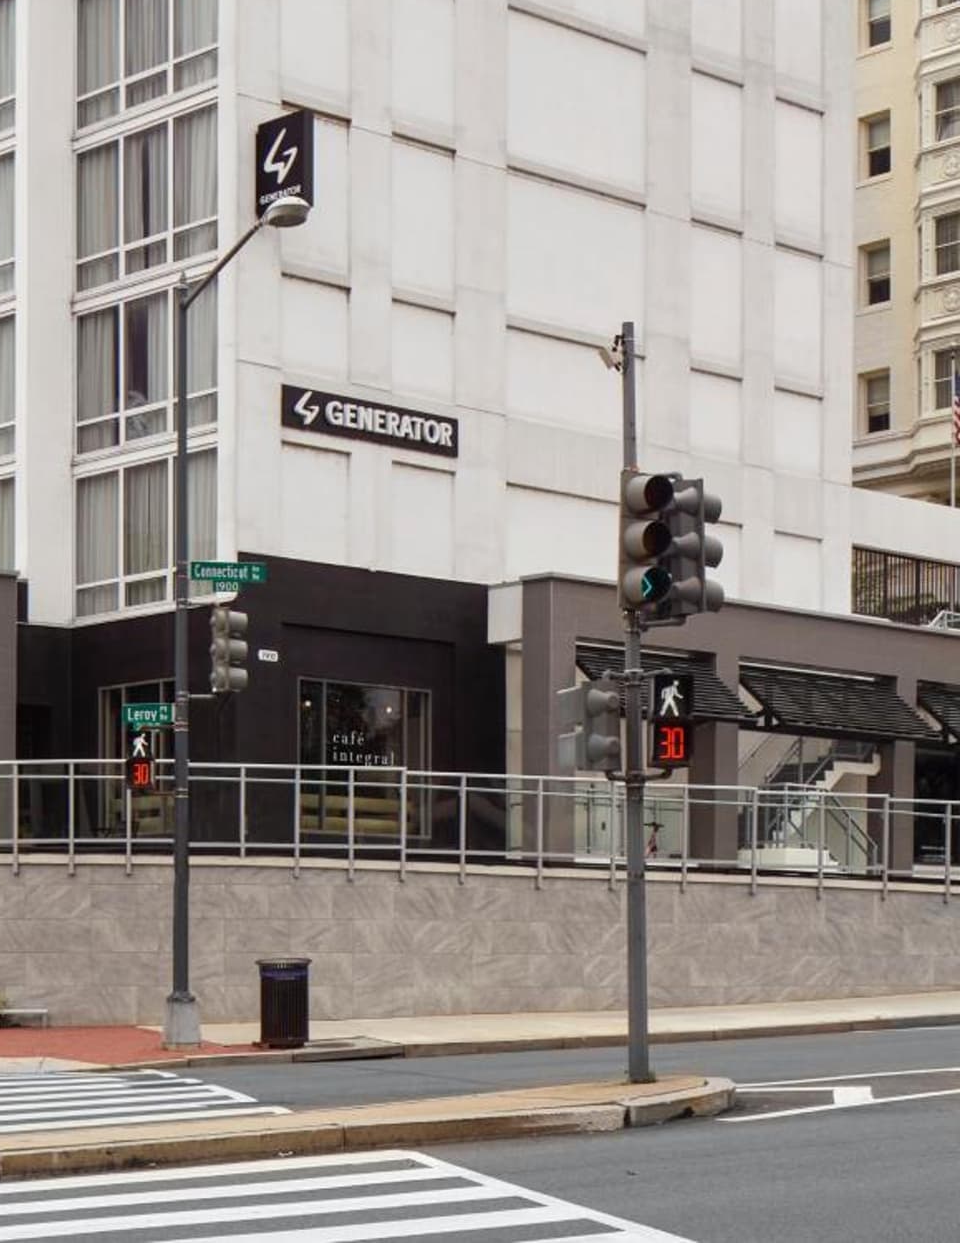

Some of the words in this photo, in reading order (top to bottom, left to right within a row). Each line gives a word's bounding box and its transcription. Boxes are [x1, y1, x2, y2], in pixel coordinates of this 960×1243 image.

[325, 400, 453, 447] GENERATOR
[194, 564, 248, 580] Connecticut
[215, 581, 239, 591] 1900
[127, 708, 157, 721] Leroy
[333, 730, 365, 745] café
[660, 727, 684, 758] 30
[333, 746, 394, 767] integral
[133, 763, 149, 784] 30
